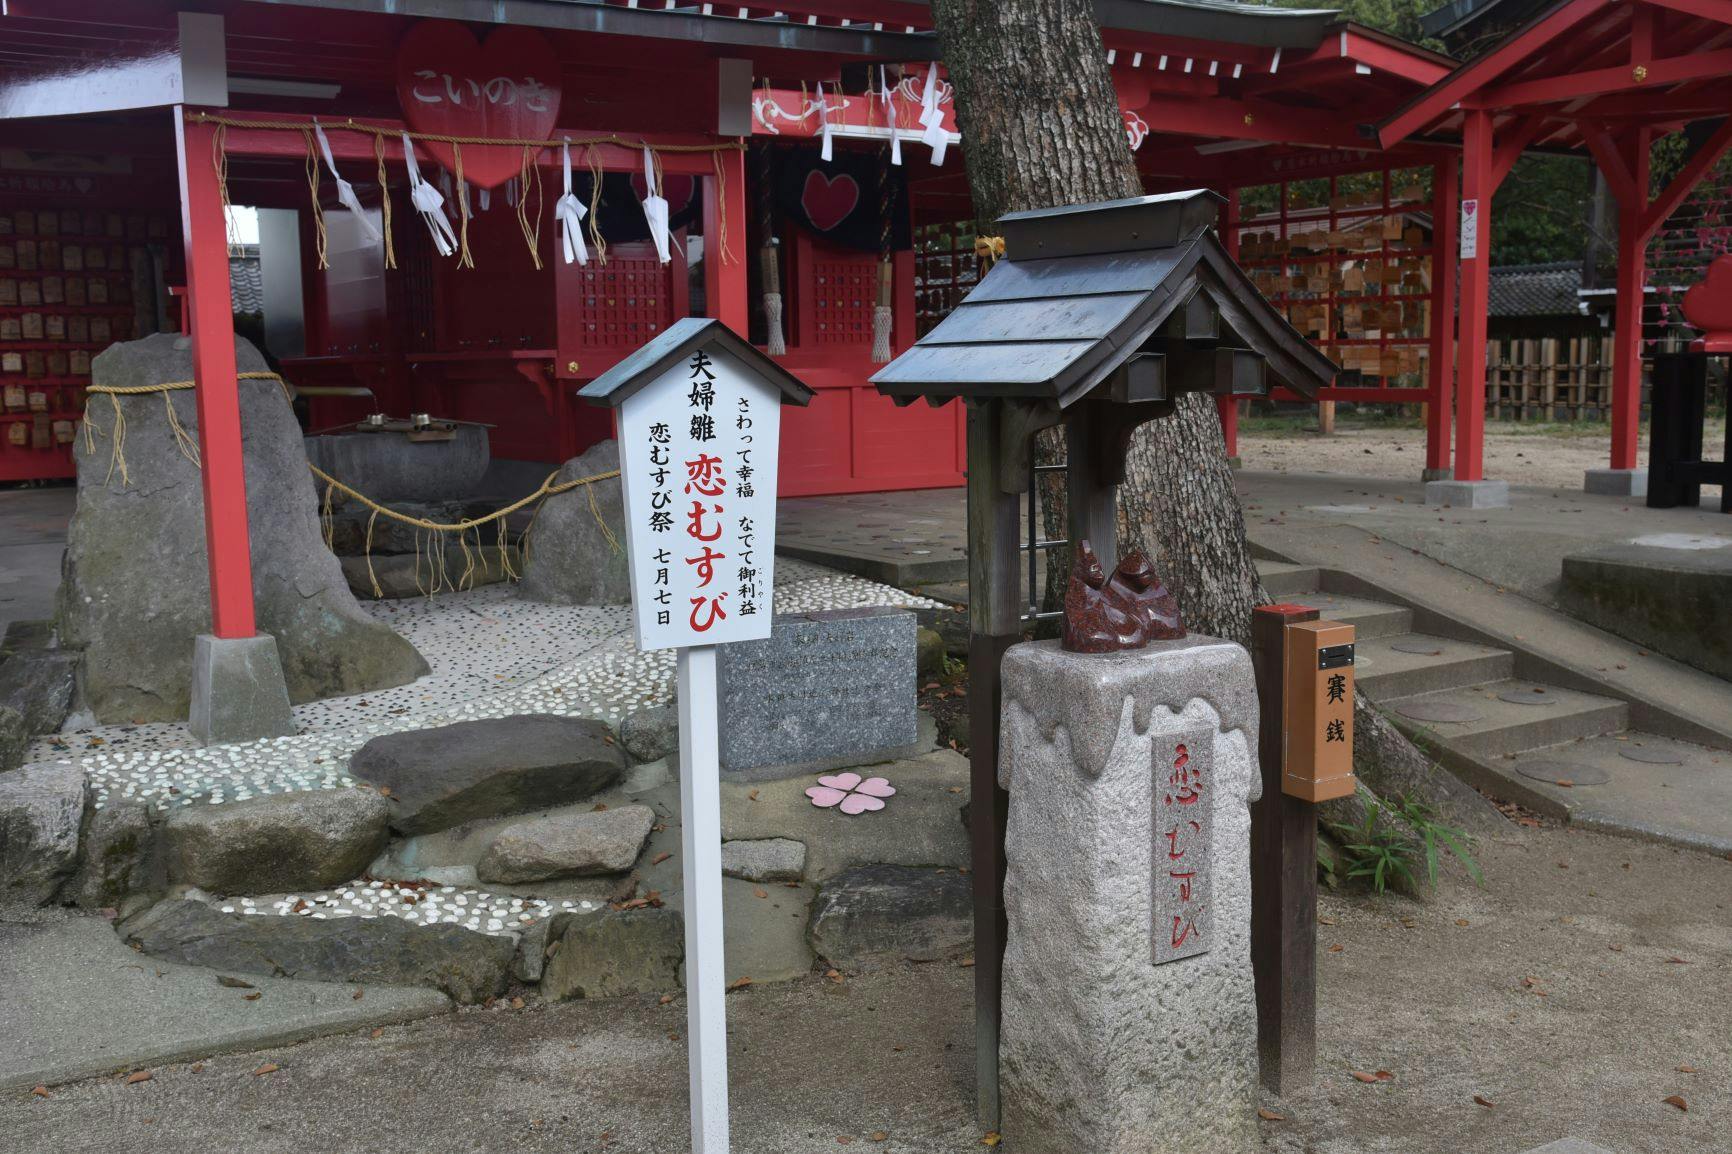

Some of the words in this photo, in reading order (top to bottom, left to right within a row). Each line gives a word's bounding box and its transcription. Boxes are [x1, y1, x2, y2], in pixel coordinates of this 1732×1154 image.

[414, 70, 550, 111] こいのき
[688, 350, 716, 442] 夫婦雛
[648, 422, 674, 533] 恋むすび祭
[736, 397, 755, 498] さわって幸福
[652, 548, 672, 625] 七月七日
[684, 453, 728, 632] 恋むすび
[737, 516, 756, 616] なでて御利益
[1164, 744, 1205, 949] 恋むすび
